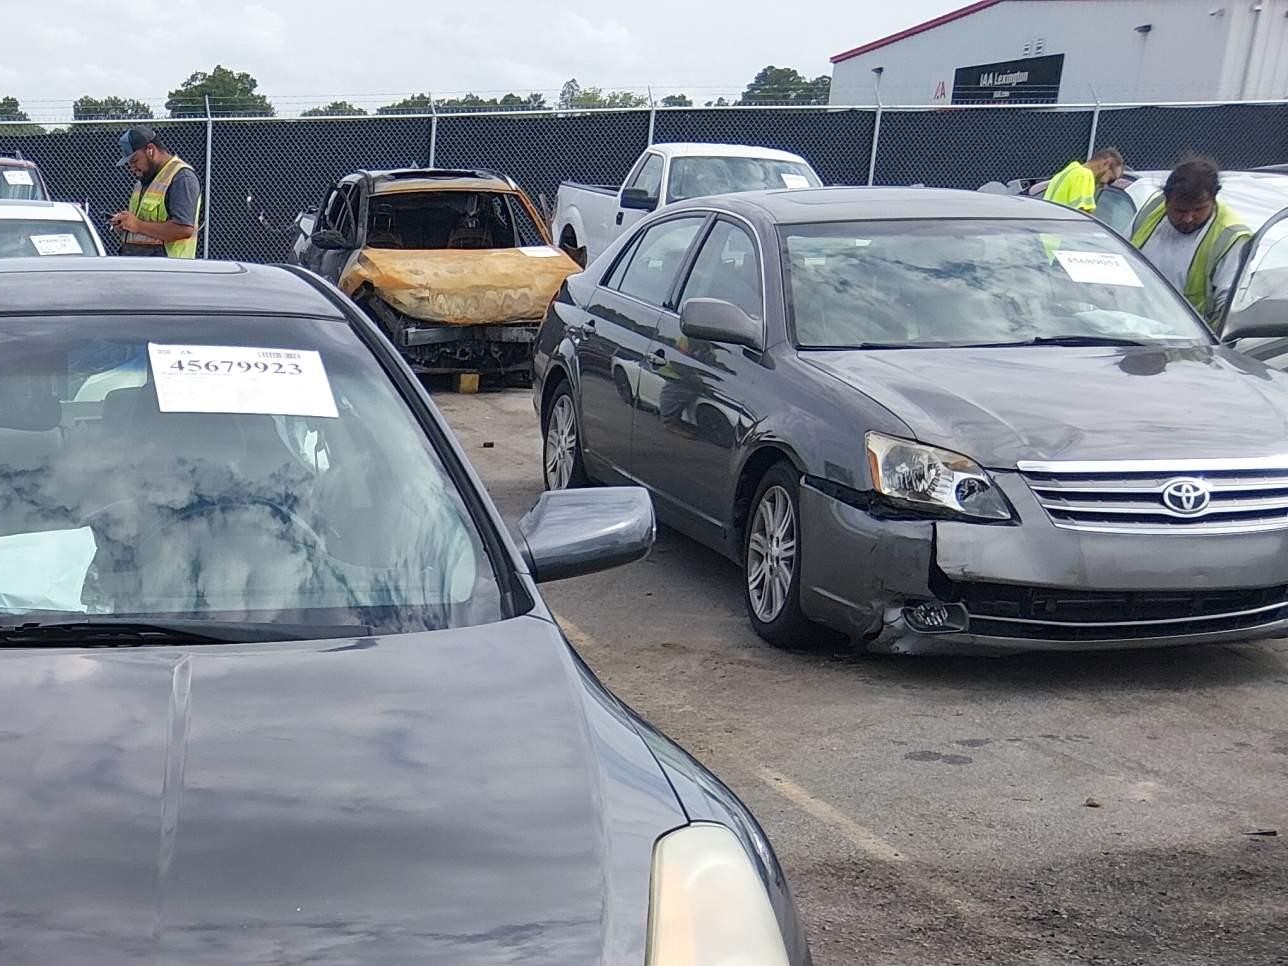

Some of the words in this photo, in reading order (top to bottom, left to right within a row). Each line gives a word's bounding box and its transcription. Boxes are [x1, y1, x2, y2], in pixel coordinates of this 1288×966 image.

[979, 73, 994, 87] IAA
[994, 71, 1029, 87] Lexington
[169, 359, 303, 375] 45679923
